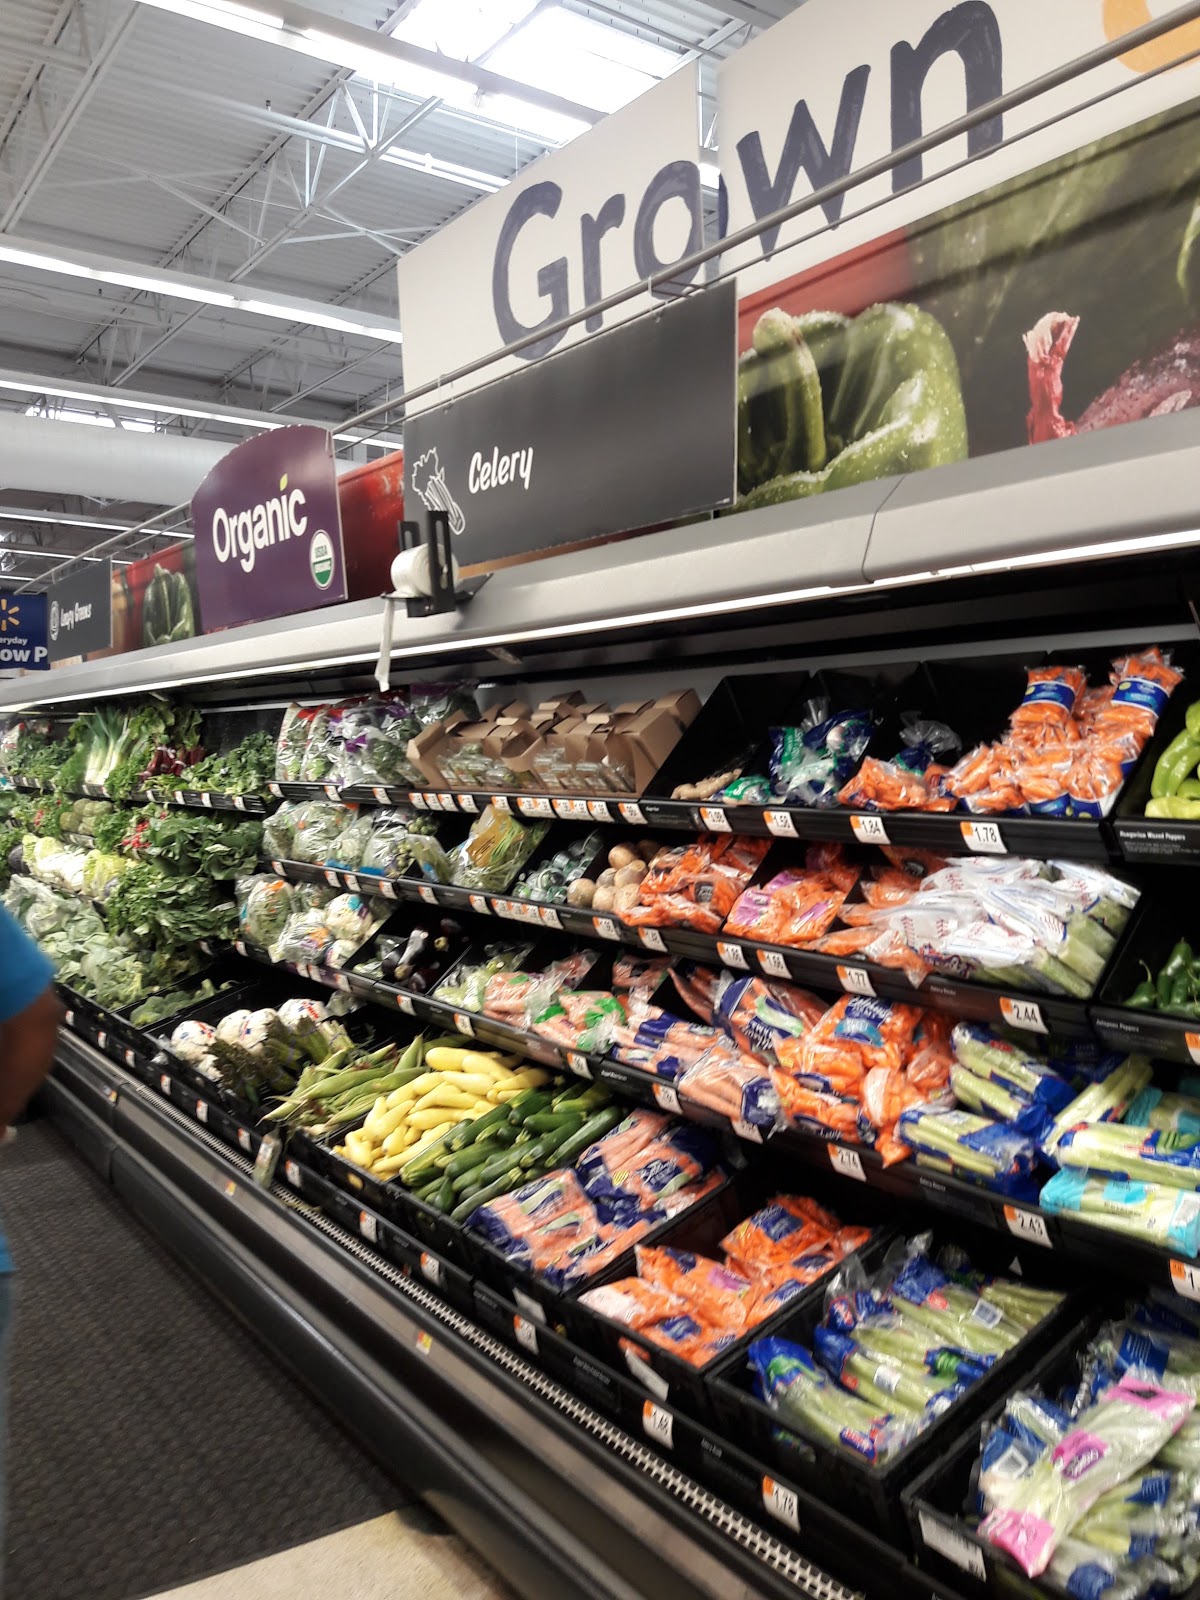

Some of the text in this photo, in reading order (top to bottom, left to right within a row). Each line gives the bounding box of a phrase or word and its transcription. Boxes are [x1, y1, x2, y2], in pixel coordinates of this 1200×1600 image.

[492, 0, 1004, 359] Grown
[468, 446, 533, 494] Celery
[212, 474, 308, 573] Organic
[34, 646, 48, 663] P
[861, 818, 882, 835] 1.84
[972, 826, 998, 844] 1.78
[847, 969, 867, 988] 1.77
[1013, 1003, 1038, 1024] 2.44
[1017, 1212, 1043, 1237] 2.43
